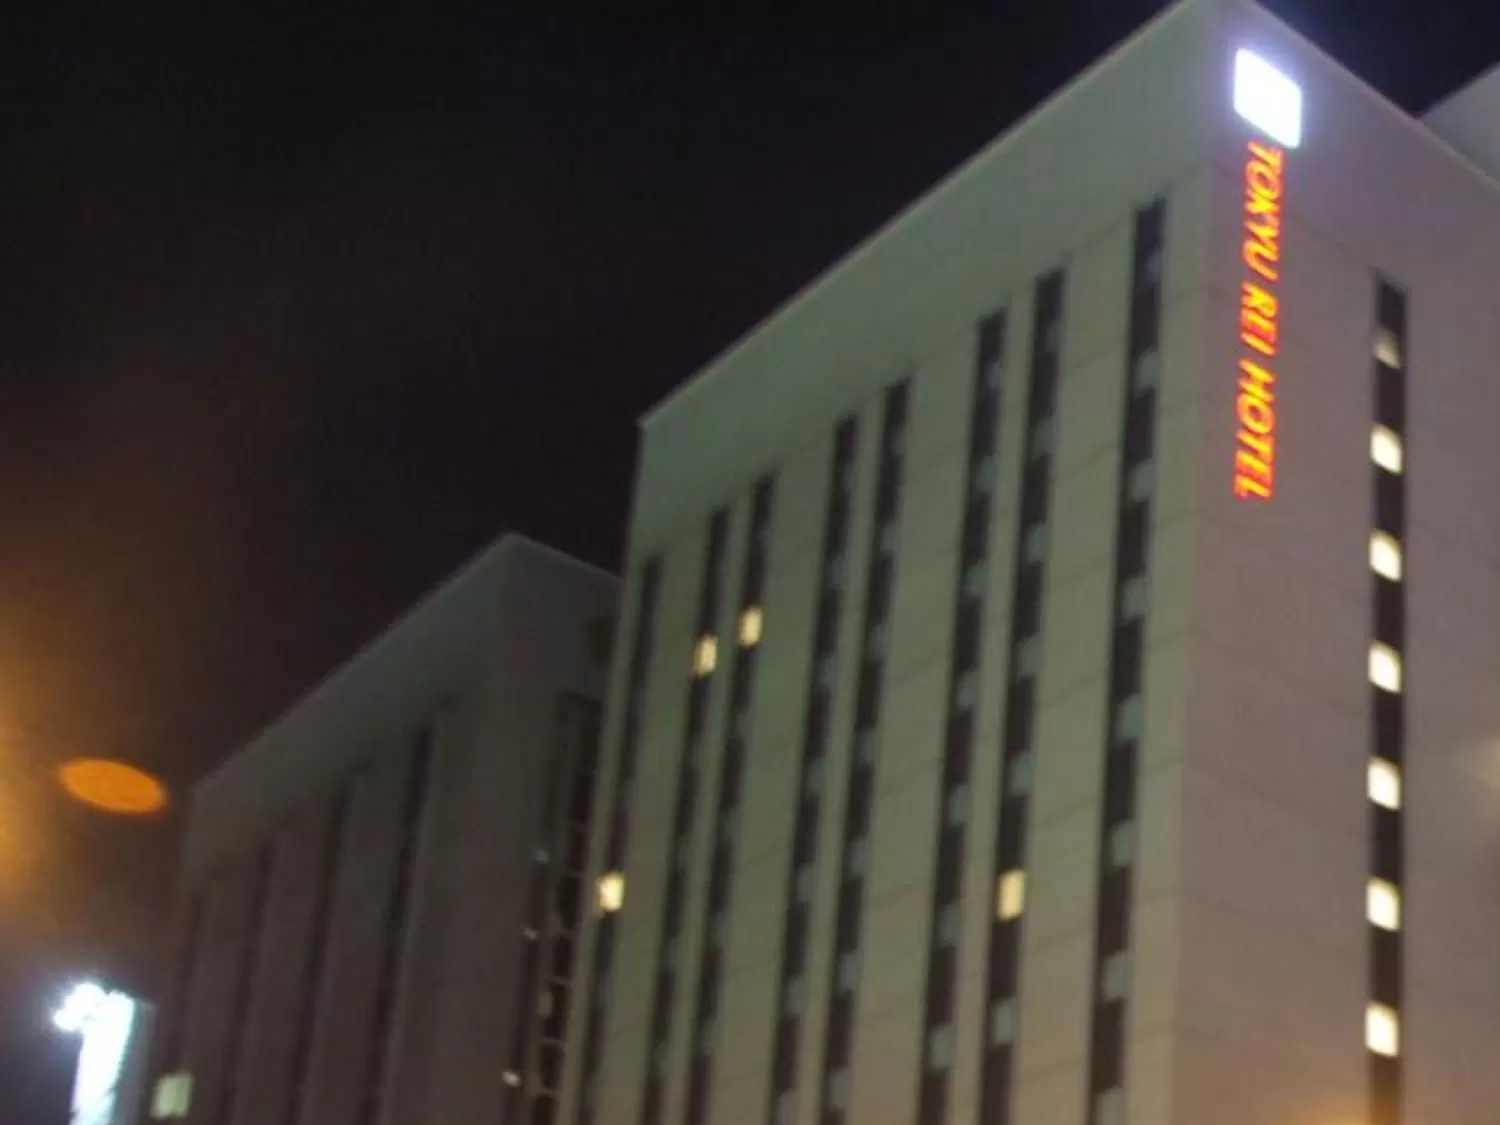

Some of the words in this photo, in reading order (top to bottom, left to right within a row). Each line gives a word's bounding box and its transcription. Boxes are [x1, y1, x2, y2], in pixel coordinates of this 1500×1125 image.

[1241, 140, 1286, 281] TOKYU
[1238, 281, 1280, 357] REI
[1234, 358, 1277, 502] HOTEL
